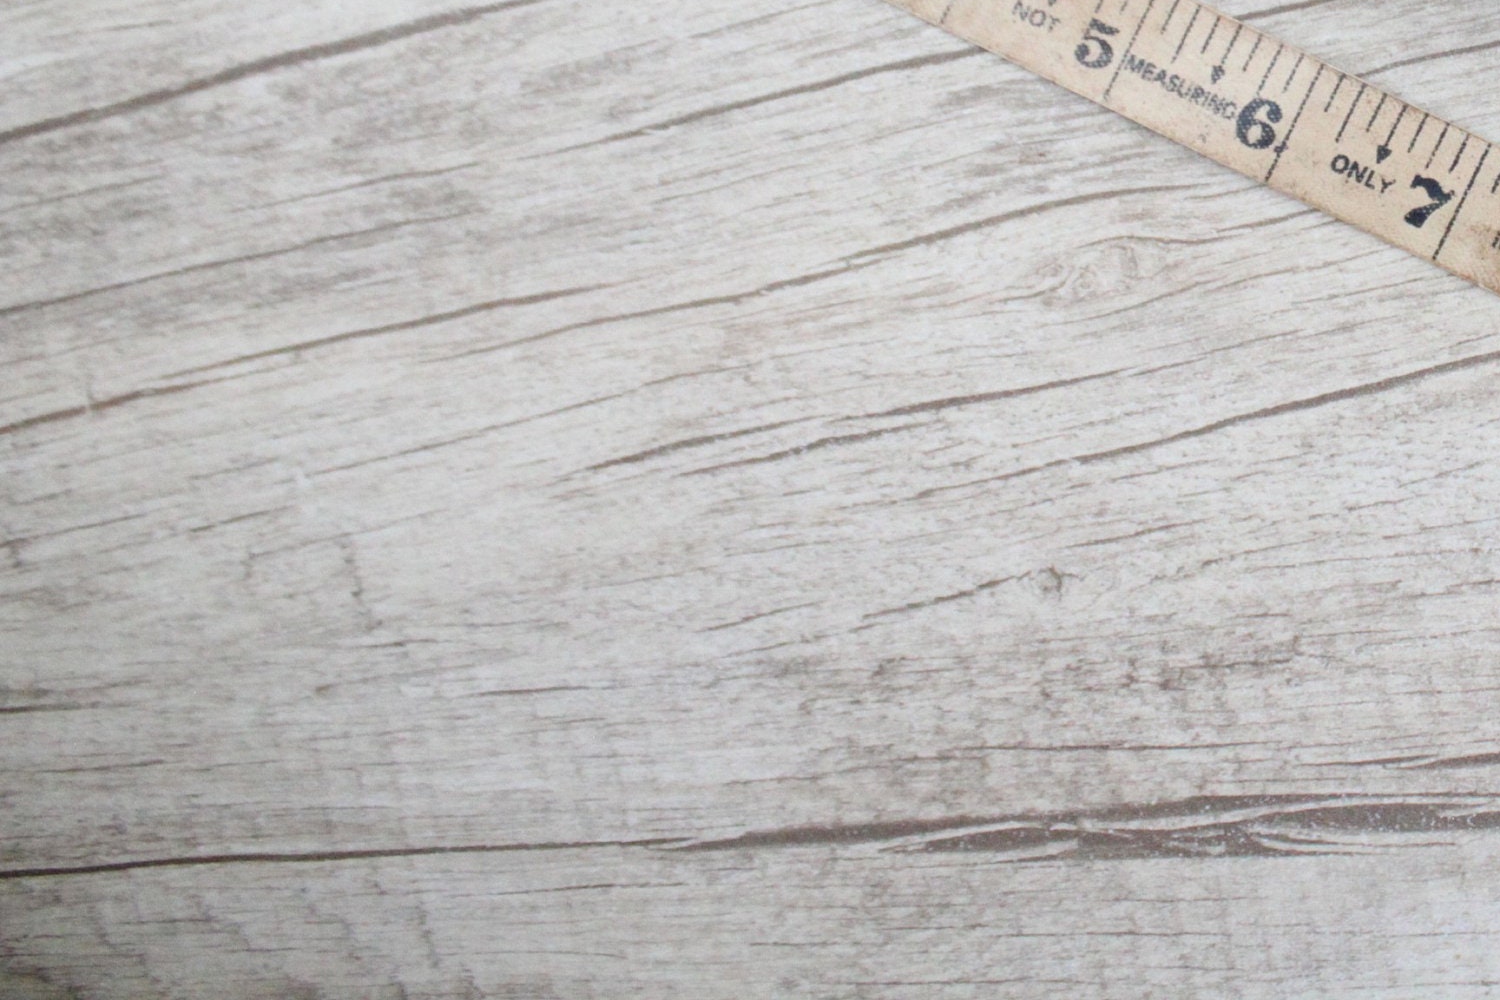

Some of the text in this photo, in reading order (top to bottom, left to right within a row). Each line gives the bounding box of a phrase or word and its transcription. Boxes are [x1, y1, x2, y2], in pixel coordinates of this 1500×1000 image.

[1011, 0, 1061, 33] NOT
[1073, 20, 1121, 69] 5
[1124, 53, 1238, 123] MEASURING
[1234, 98, 1284, 150] 6
[1330, 153, 1397, 194] ONLY
[1401, 173, 1456, 230] 7
